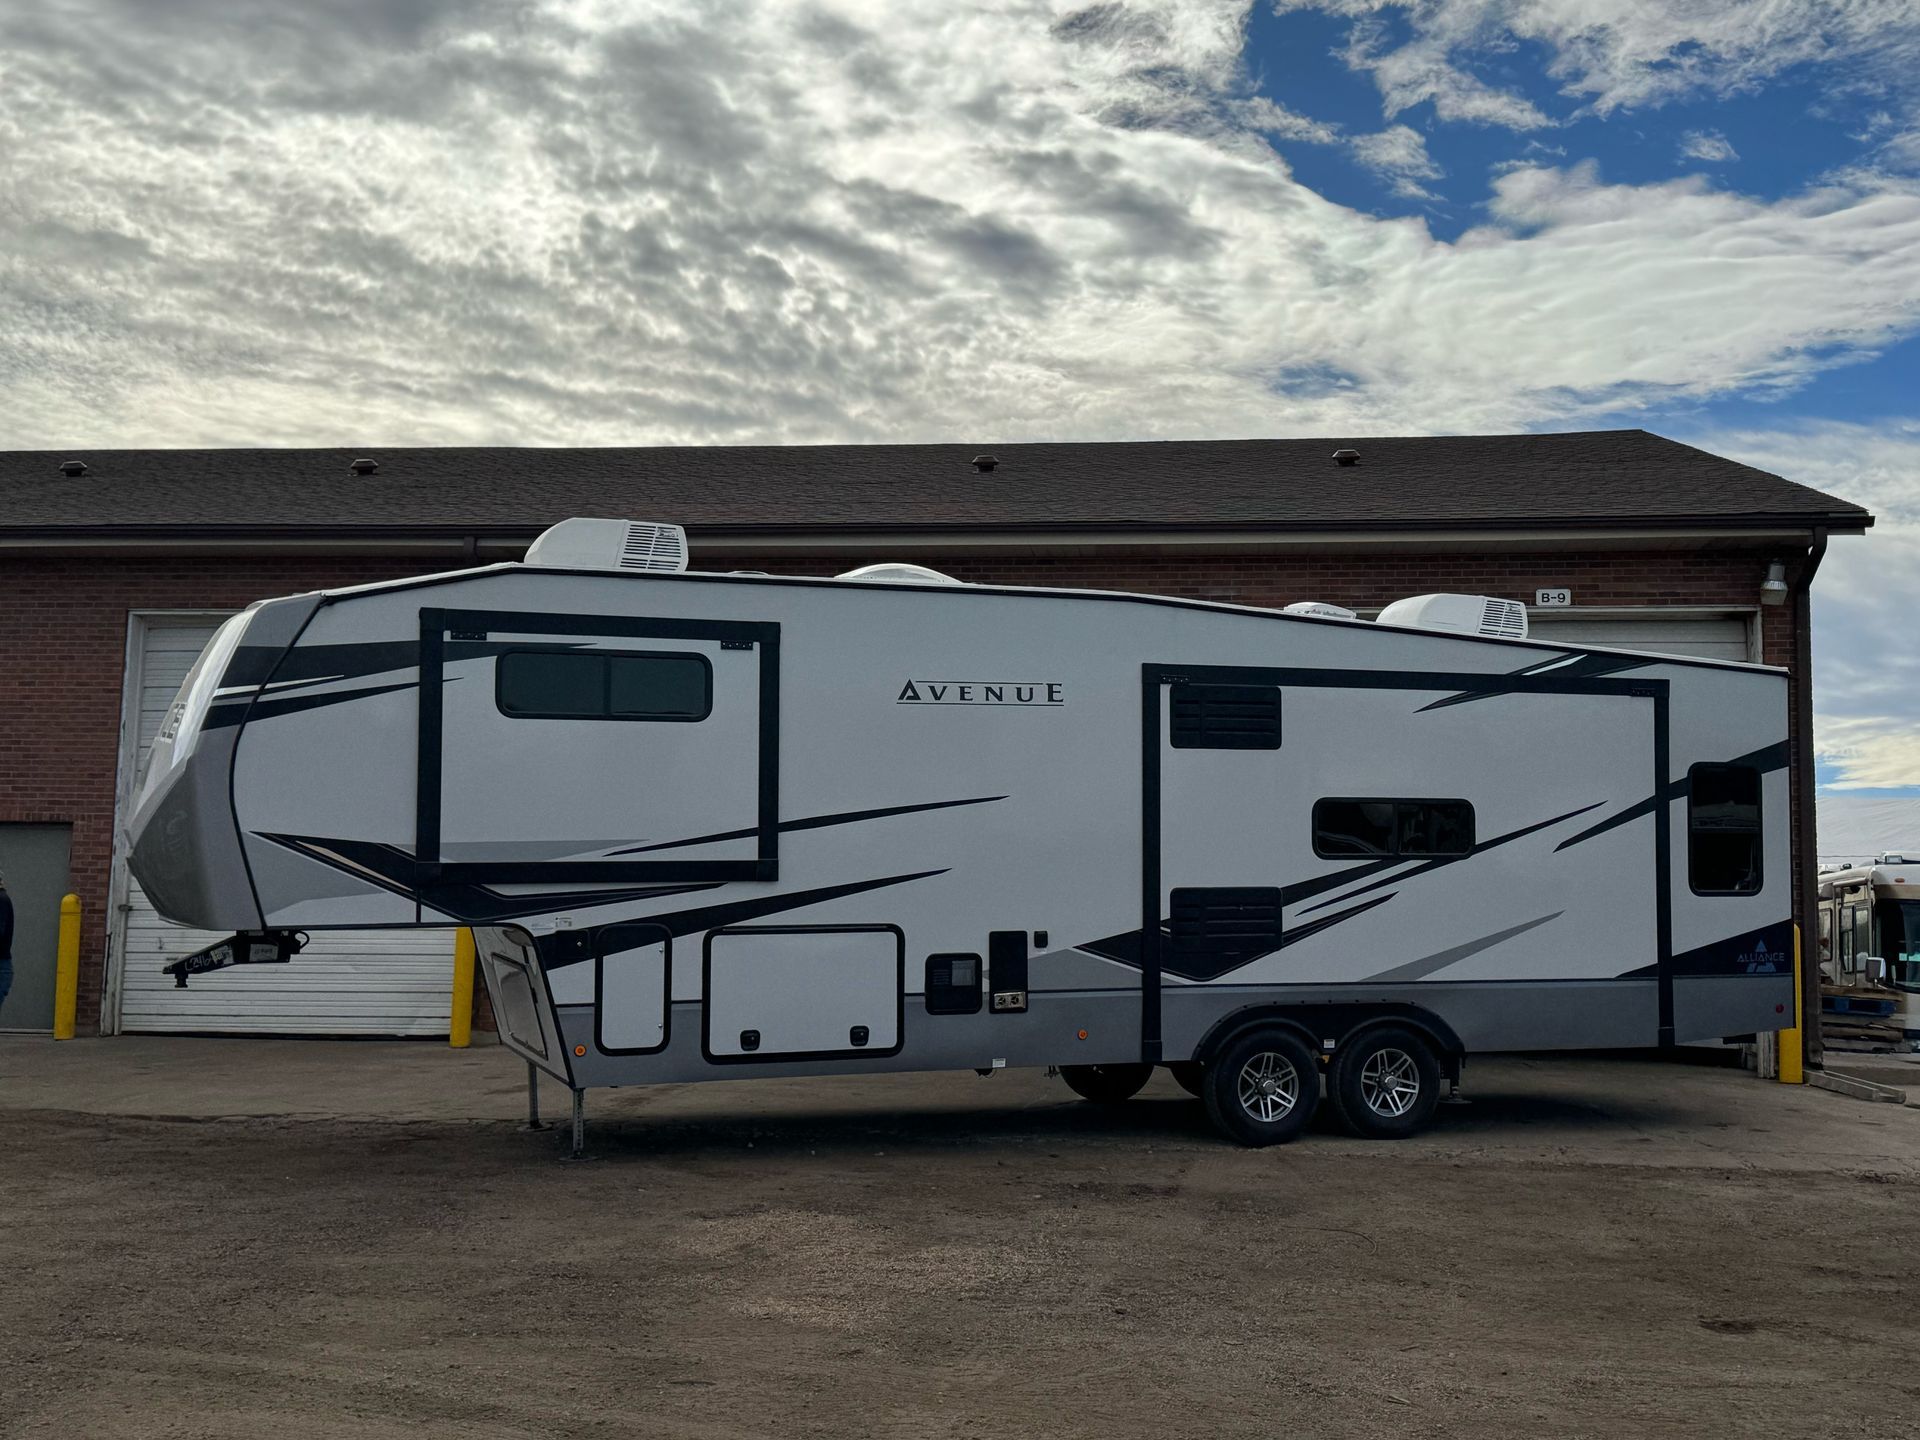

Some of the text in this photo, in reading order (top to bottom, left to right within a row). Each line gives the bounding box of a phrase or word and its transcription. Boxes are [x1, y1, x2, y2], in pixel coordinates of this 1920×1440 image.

[1541, 592, 1566, 603] B-9
[898, 679, 1064, 702] AVENUE
[1736, 952, 1785, 962] ALLIANCE
